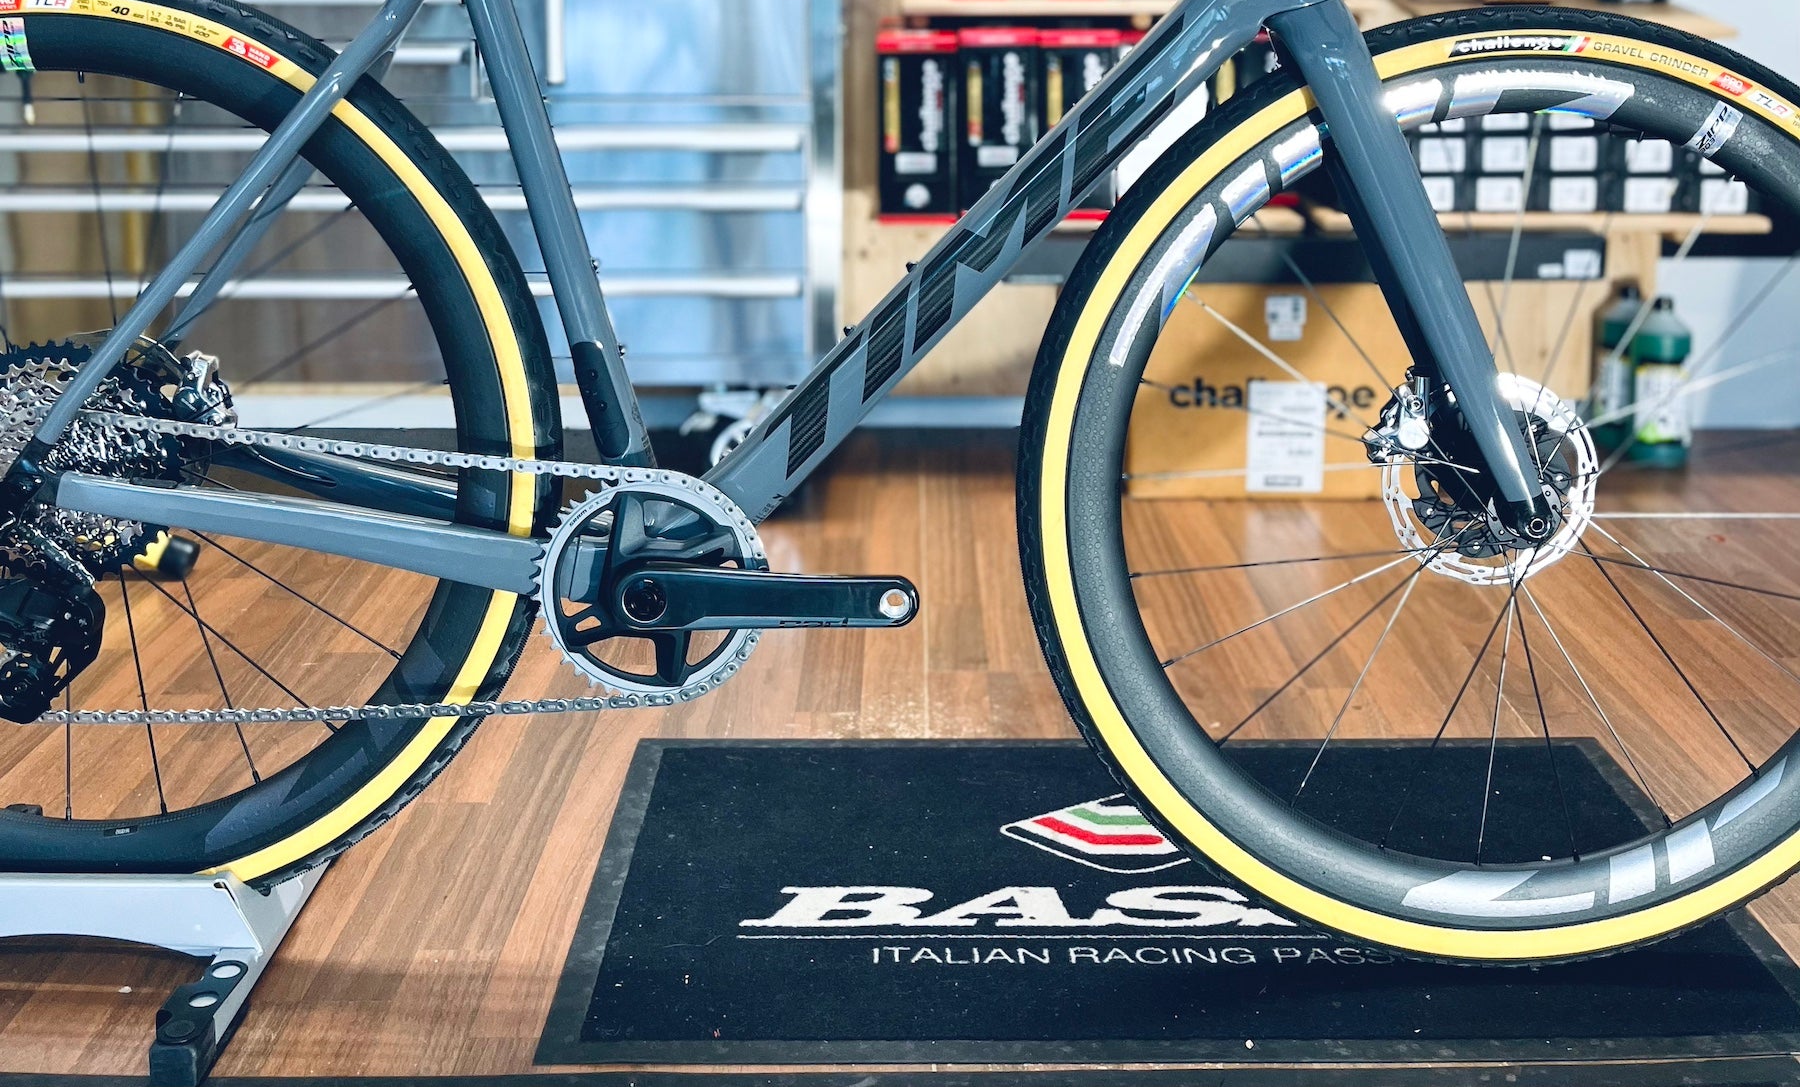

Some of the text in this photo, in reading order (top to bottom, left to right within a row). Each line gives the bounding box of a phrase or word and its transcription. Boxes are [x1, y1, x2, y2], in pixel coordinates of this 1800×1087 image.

[111, 5, 130, 16] 40
[1459, 36, 1709, 78] challenge GRAVEL GRINDER
[1756, 93, 1789, 116] TLR
[1695, 105, 1728, 150] ZIPP
[1169, 378, 1376, 420] chage
[738, 885, 1299, 927] BAS
[871, 945, 1396, 965] ITALIAN RACING PASS
